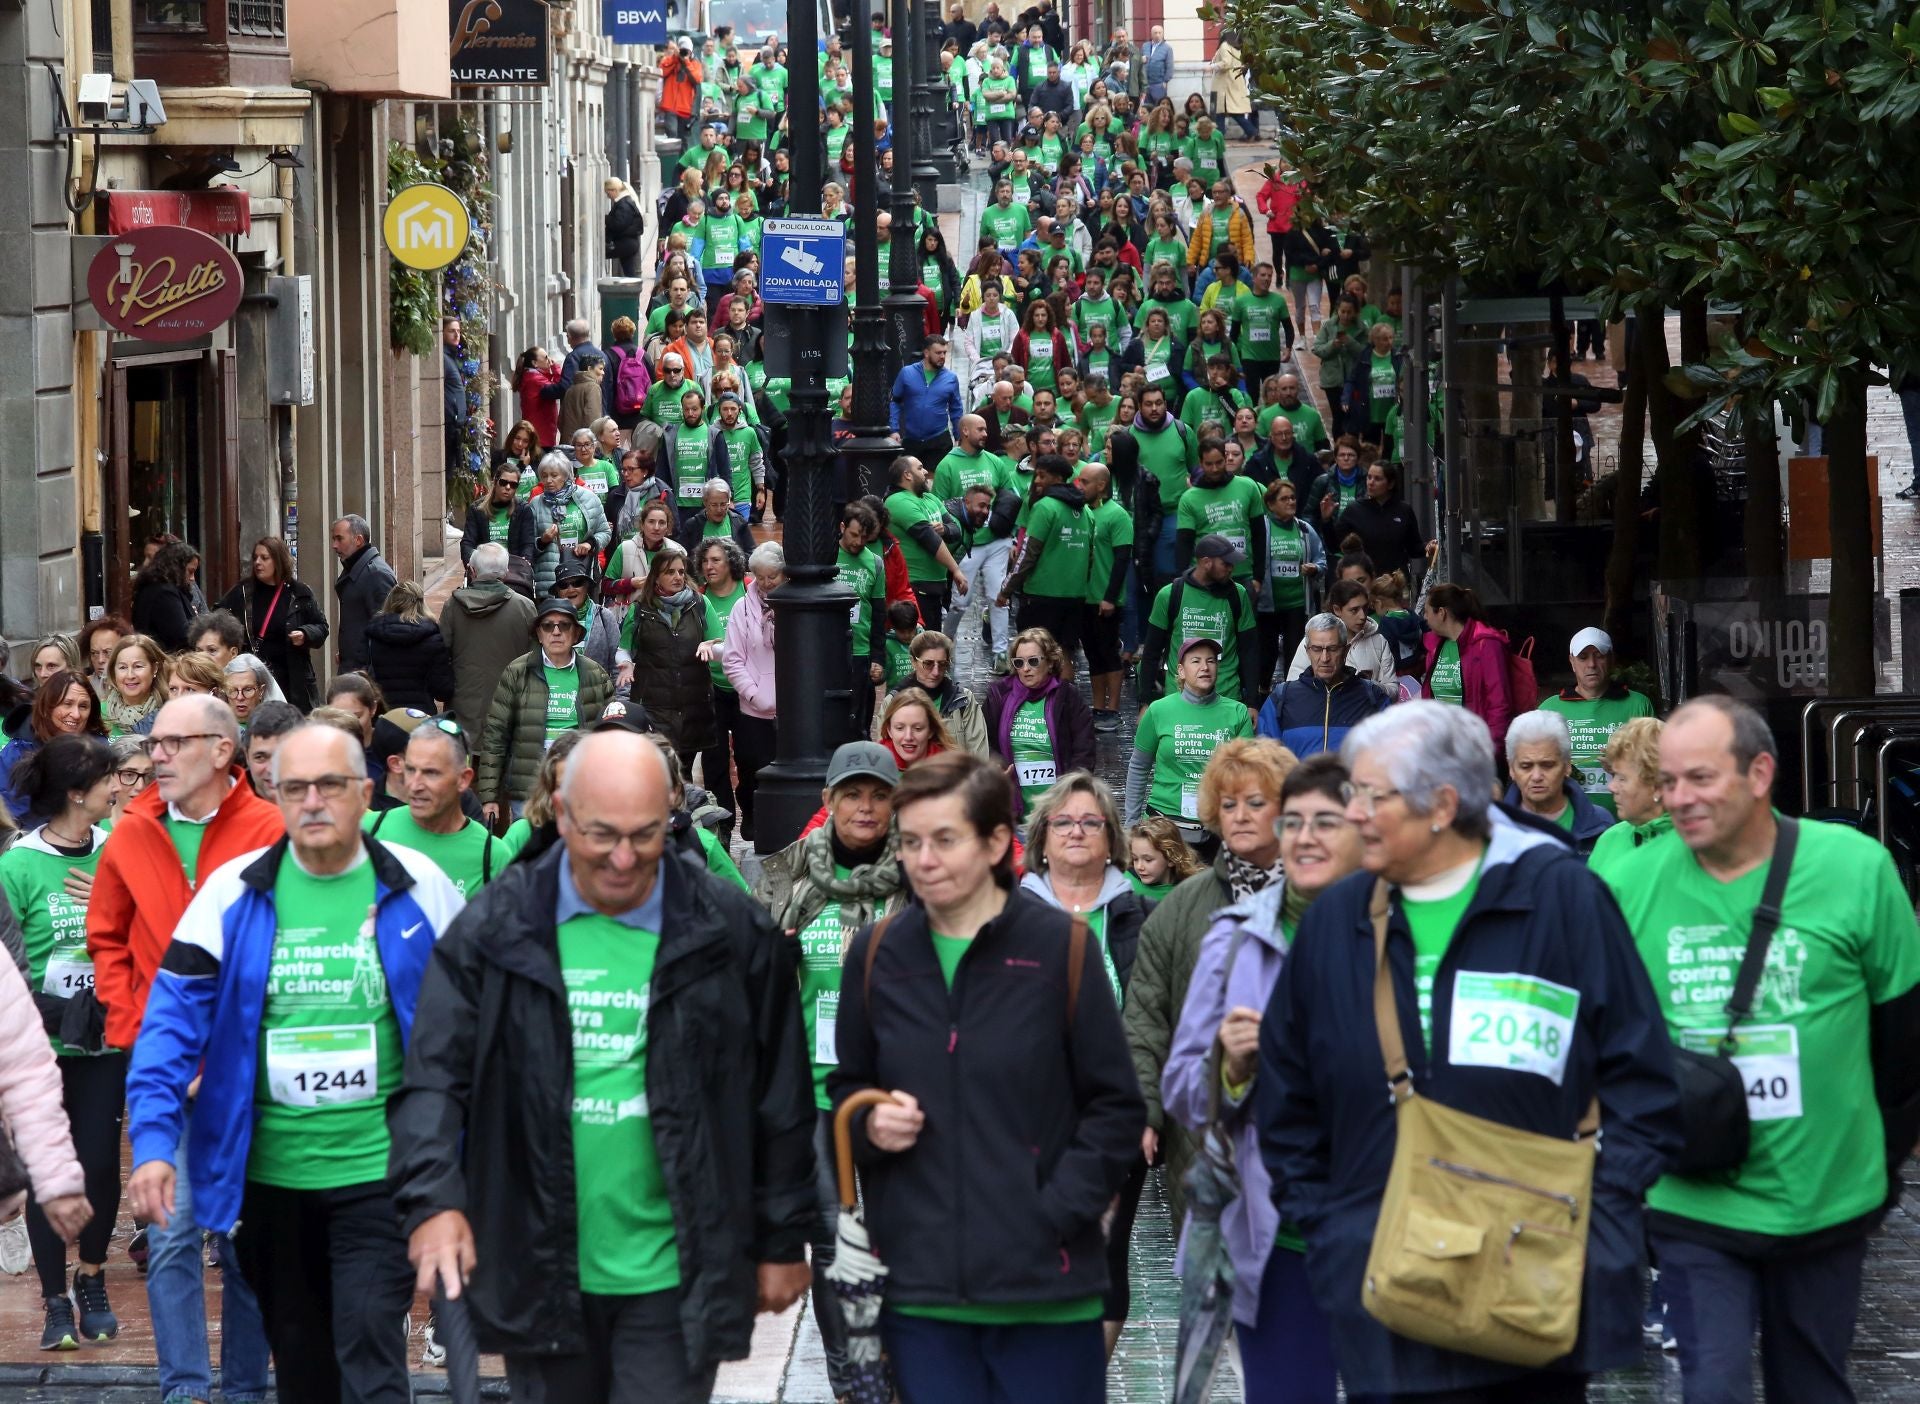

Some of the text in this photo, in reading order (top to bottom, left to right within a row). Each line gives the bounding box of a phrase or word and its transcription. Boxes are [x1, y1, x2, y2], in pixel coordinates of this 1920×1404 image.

[617, 10, 661, 25] BBVA
[780, 223, 835, 232] POLICIA LOCAL
[107, 256, 226, 318] Rialto
[765, 277, 839, 288] ZONA VIGILADA
[157, 319, 205, 328] desde 1926
[1278, 565, 1297, 573] 1044
[1175, 731, 1186, 739] En
[1174, 738, 1203, 747] contra
[1175, 747, 1183, 755] el
[1023, 768, 1055, 780] 1772
[49, 904, 68, 917] En
[54, 930, 66, 942] el
[1667, 945, 1695, 965] En
[1668, 964, 1732, 984] contra
[284, 977, 353, 995] cáncer
[1670, 985, 1687, 1005] el
[1467, 1011, 1562, 1059] 2048
[294, 1069, 367, 1092] 1244
